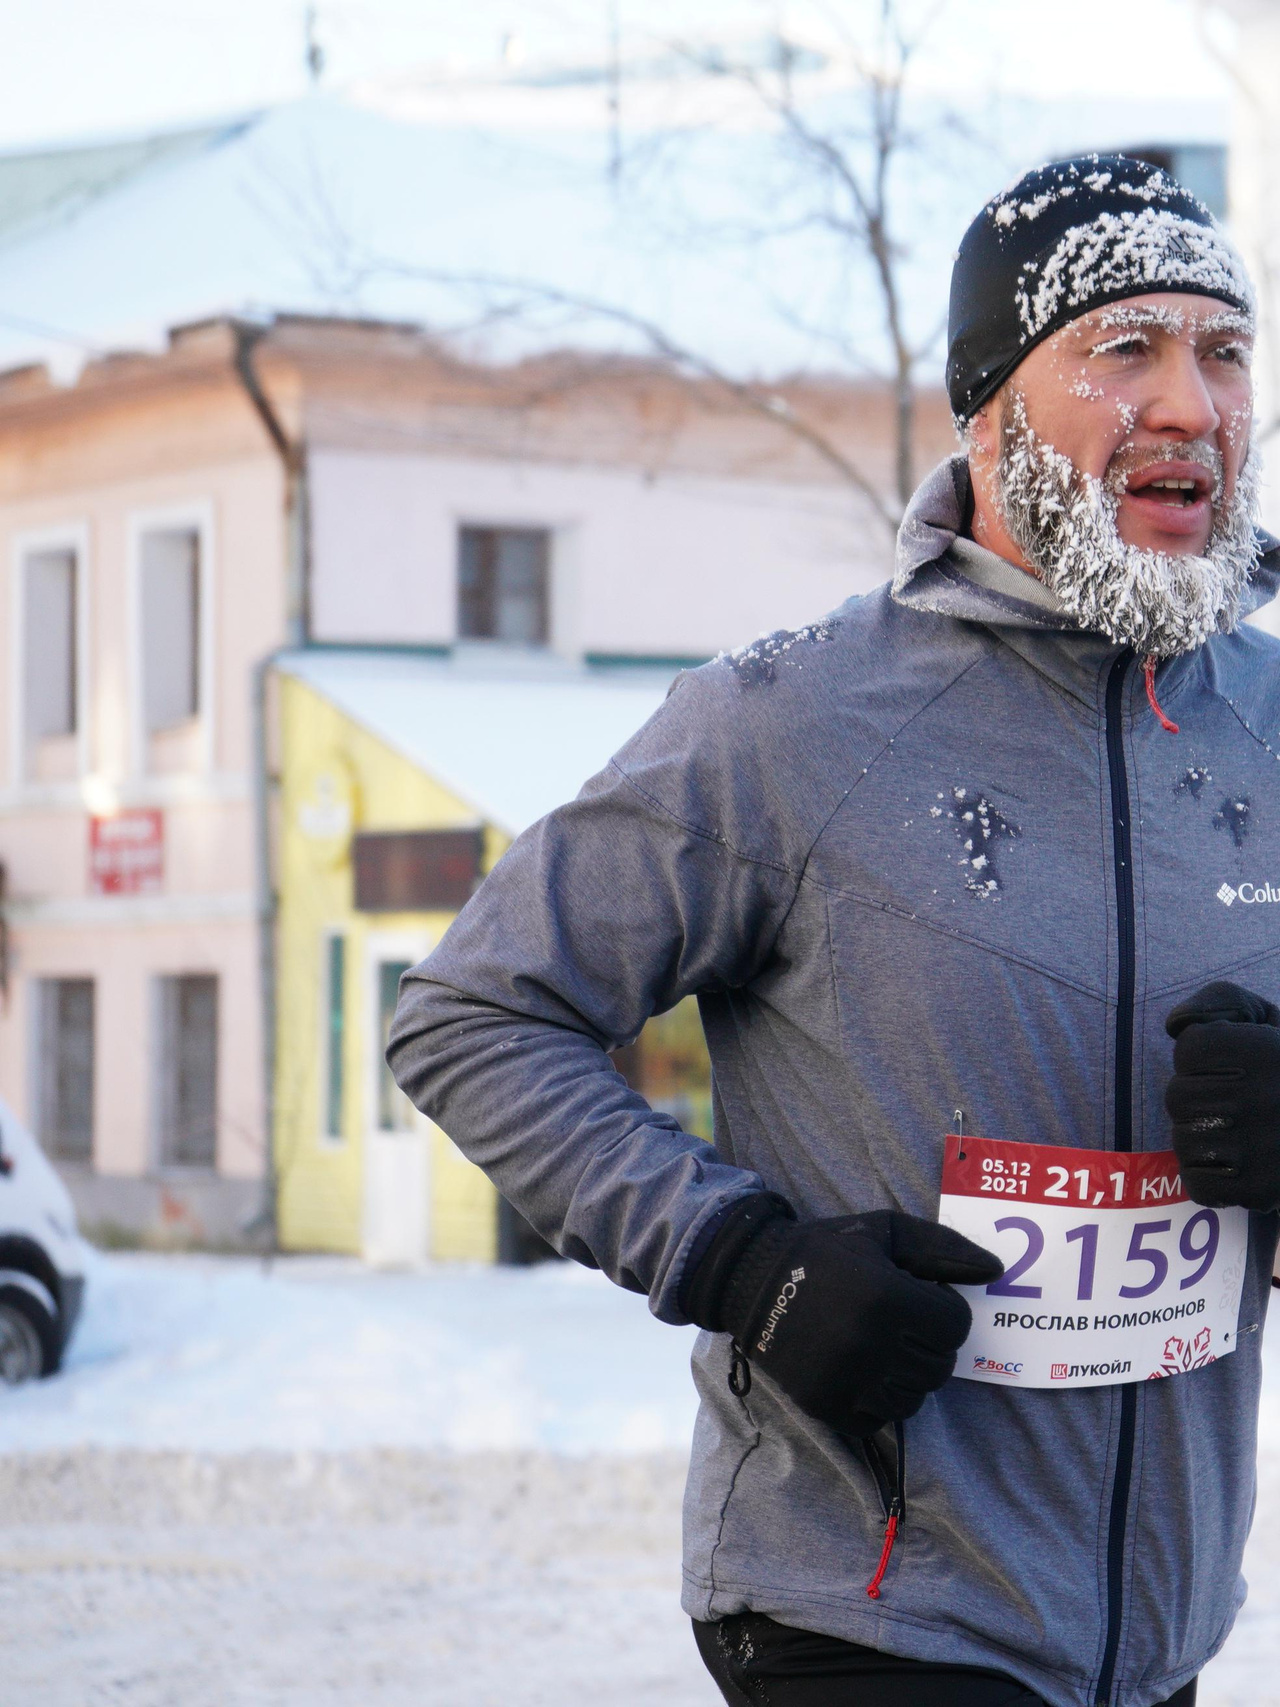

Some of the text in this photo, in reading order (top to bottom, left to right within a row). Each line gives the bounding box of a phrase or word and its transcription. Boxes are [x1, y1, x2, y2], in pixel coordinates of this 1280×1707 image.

[982, 1158, 1031, 1176] 05.12
[980, 1175, 1028, 1195] 2021
[1044, 1166, 1182, 1205] 21,1 КМ
[985, 1208, 1221, 1301] 2159
[757, 1282, 797, 1352] Columbia
[993, 1297, 1206, 1331] ЯРОСЛАВ НОМОКОНОВ
[1068, 1359, 1132, 1378] ЛУКОЙЛ
